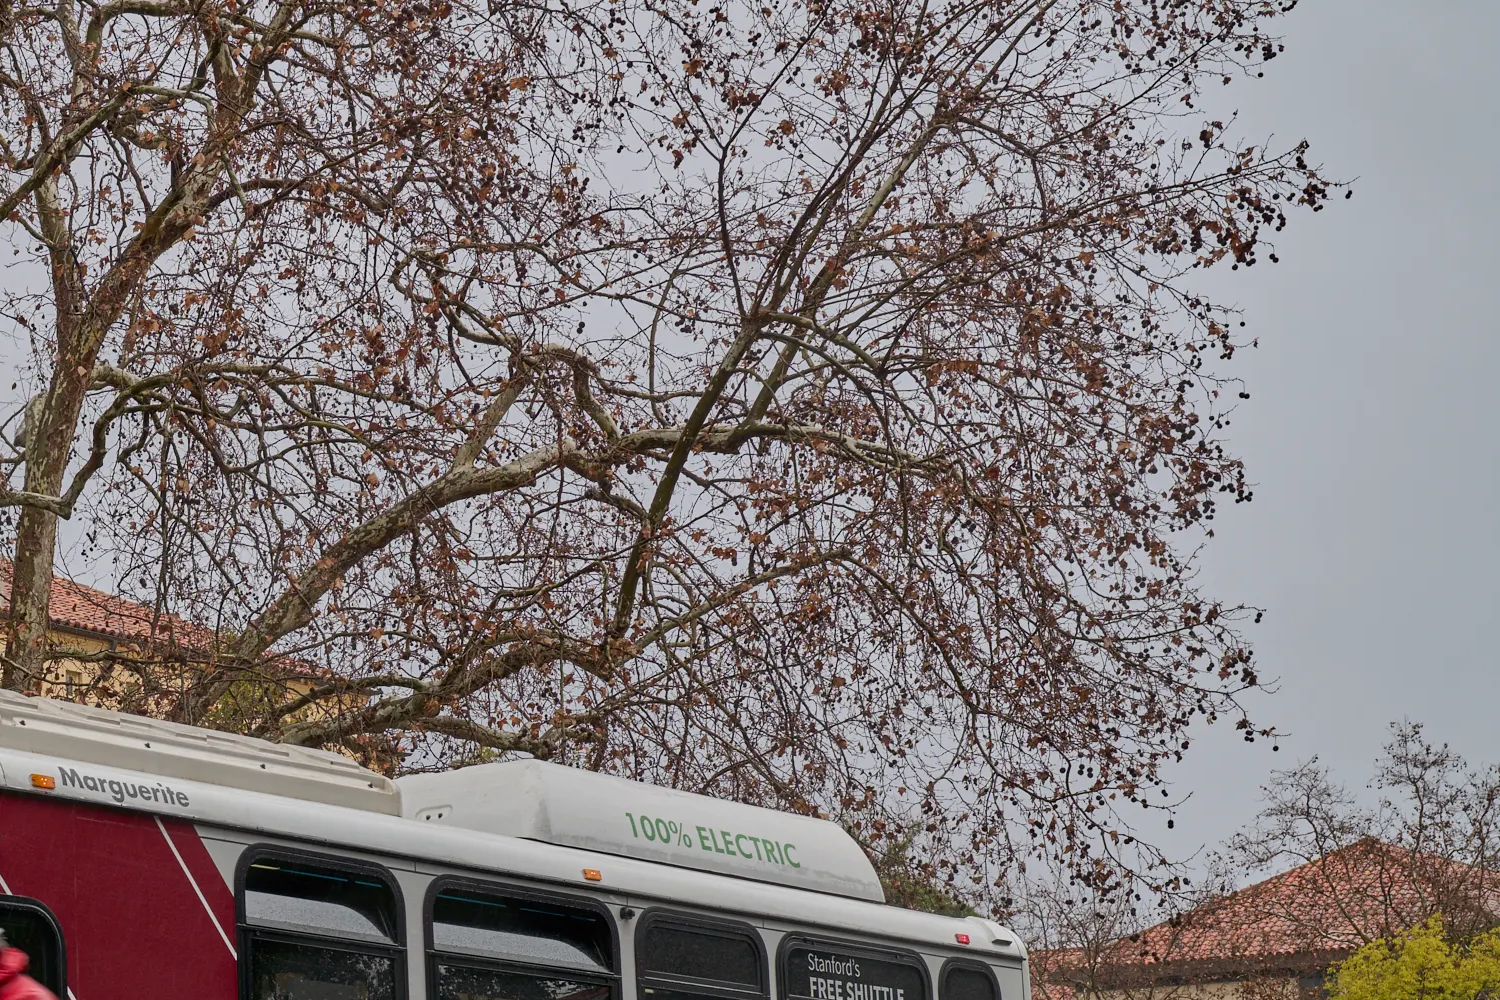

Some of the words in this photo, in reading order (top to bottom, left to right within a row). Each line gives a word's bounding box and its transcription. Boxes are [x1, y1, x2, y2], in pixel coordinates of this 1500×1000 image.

[57, 766, 191, 808] Marguerite
[625, 812, 693, 848] 100%
[695, 825, 801, 868] ELECTRIC
[807, 953, 861, 978] Stanford's
[809, 976, 843, 1000] FREE
